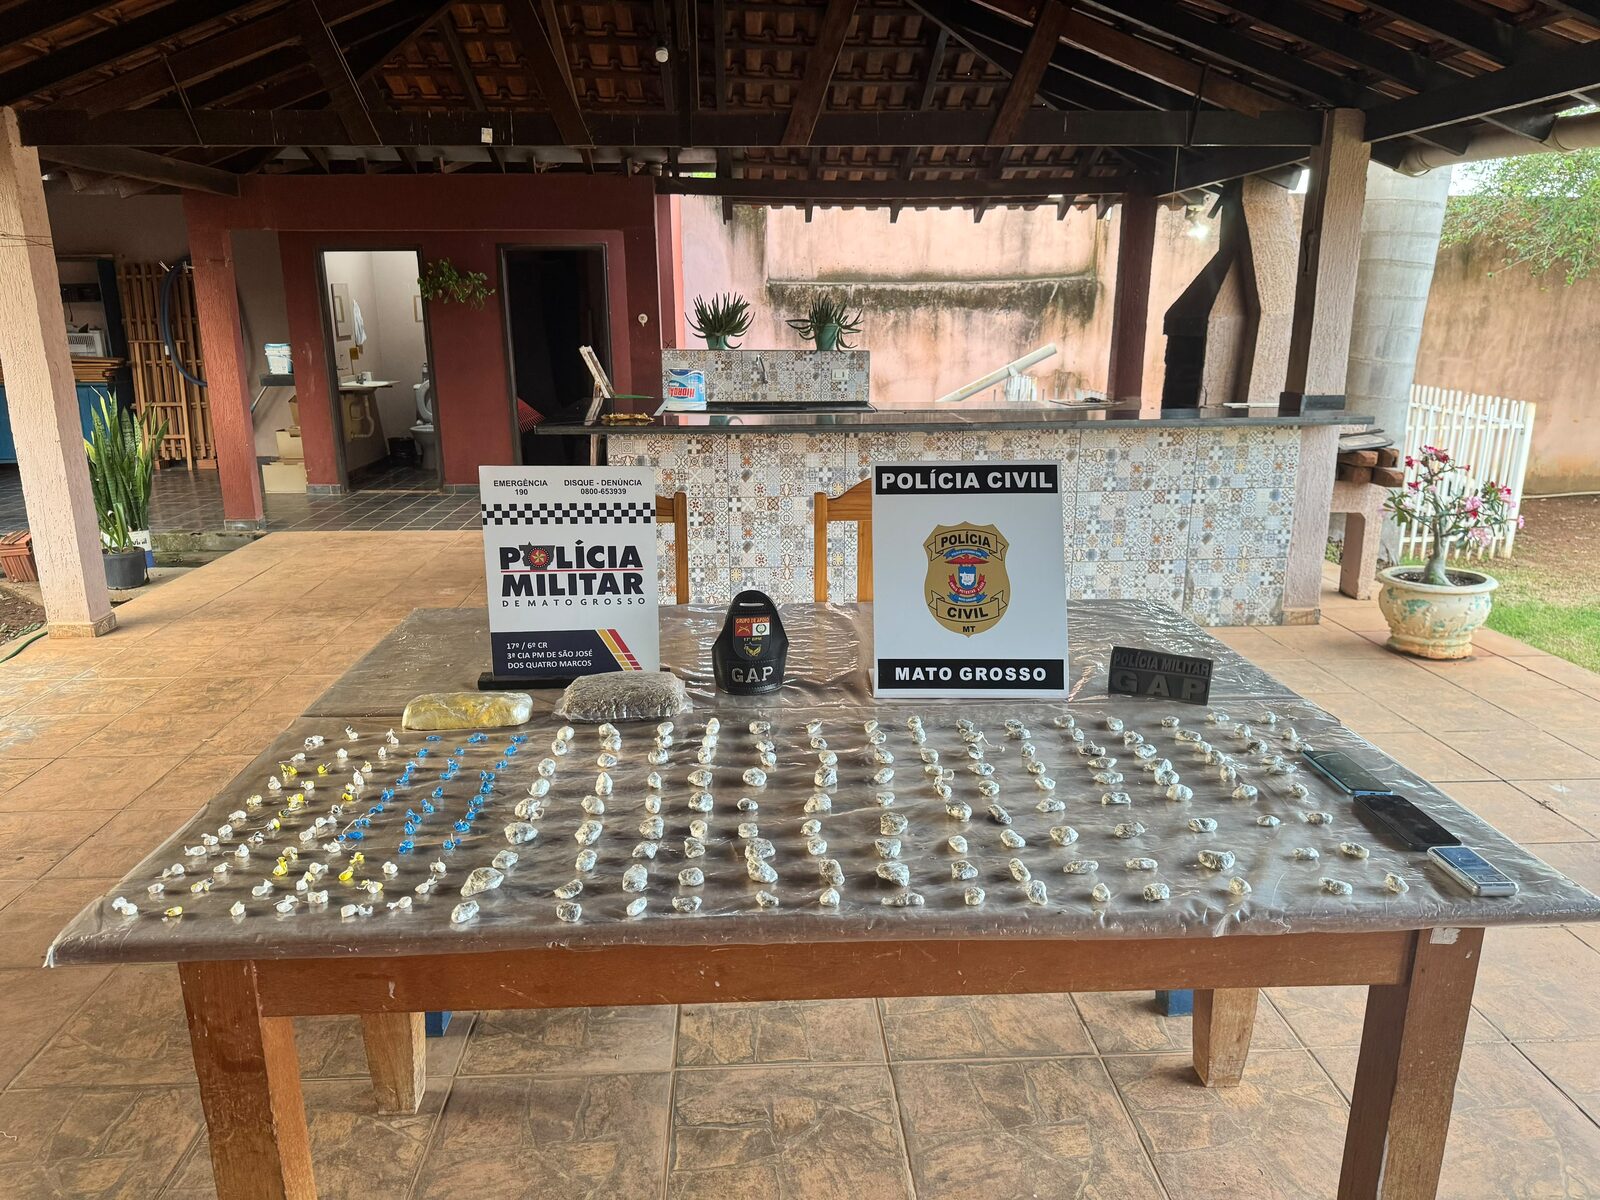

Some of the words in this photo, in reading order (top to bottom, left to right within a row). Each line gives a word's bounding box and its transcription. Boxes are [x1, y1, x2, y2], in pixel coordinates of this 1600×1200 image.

[493, 478, 548, 487] EMERGÊNCIA
[564, 479, 595, 487] DISQUE
[601, 477, 643, 487] DENÚNCIA
[881, 469, 980, 489] POLÍCIA
[987, 471, 1053, 488] CIVIL
[514, 488, 528, 496] 190
[940, 531, 991, 548] POLÍCIA
[502, 572, 645, 597] MILITAR
[580, 597, 646, 606] GROSSO
[947, 607, 989, 620] CIVIL
[506, 642, 520, 650] 17º
[532, 651, 546, 659] PM
[558, 650, 574, 658] SÃO
[575, 649, 593, 658] JOSÉ
[526, 661, 558, 669] QUATRO
[559, 660, 592, 668] MARCOS
[1113, 651, 1158, 670] POLÍCIA
[1161, 657, 1210, 676] MILITAR
[731, 666, 774, 683] GAP
[894, 667, 952, 681] MATO
[959, 666, 1047, 682] GROSSO
[1112, 670, 1207, 700] GAP
